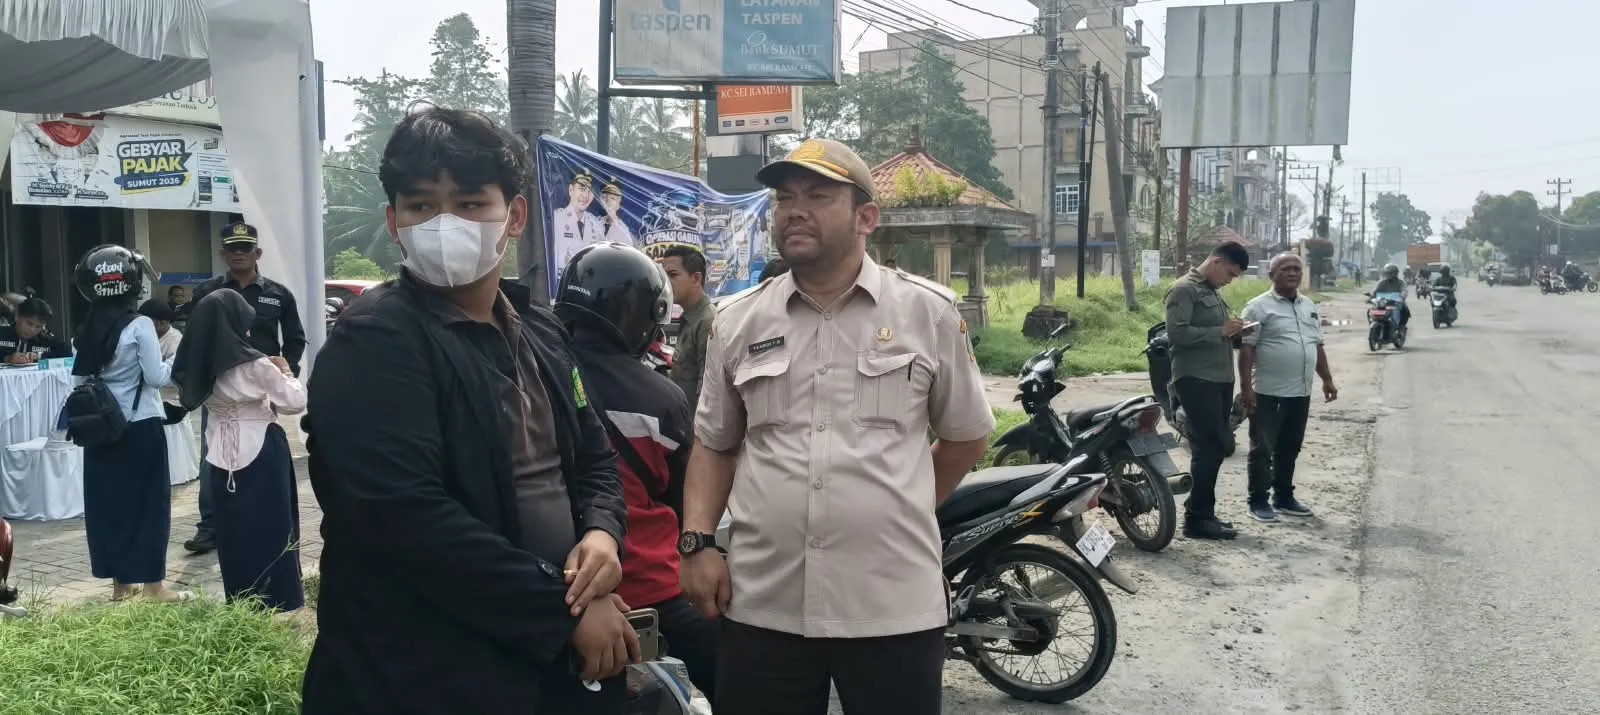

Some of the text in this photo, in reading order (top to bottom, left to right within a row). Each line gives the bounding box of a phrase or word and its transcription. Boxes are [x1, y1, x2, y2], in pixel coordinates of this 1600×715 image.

[629, 12, 711, 36] taspen
[742, 12, 803, 25] TASPEN
[721, 84, 788, 98] KC SEI RAMPAH
[119, 141, 183, 157] GEBYAR
[122, 156, 184, 174] PAJAK
[127, 177, 181, 188] SUMUT 2026
[95, 261, 124, 276] Start
[93, 280, 129, 297] Smile
